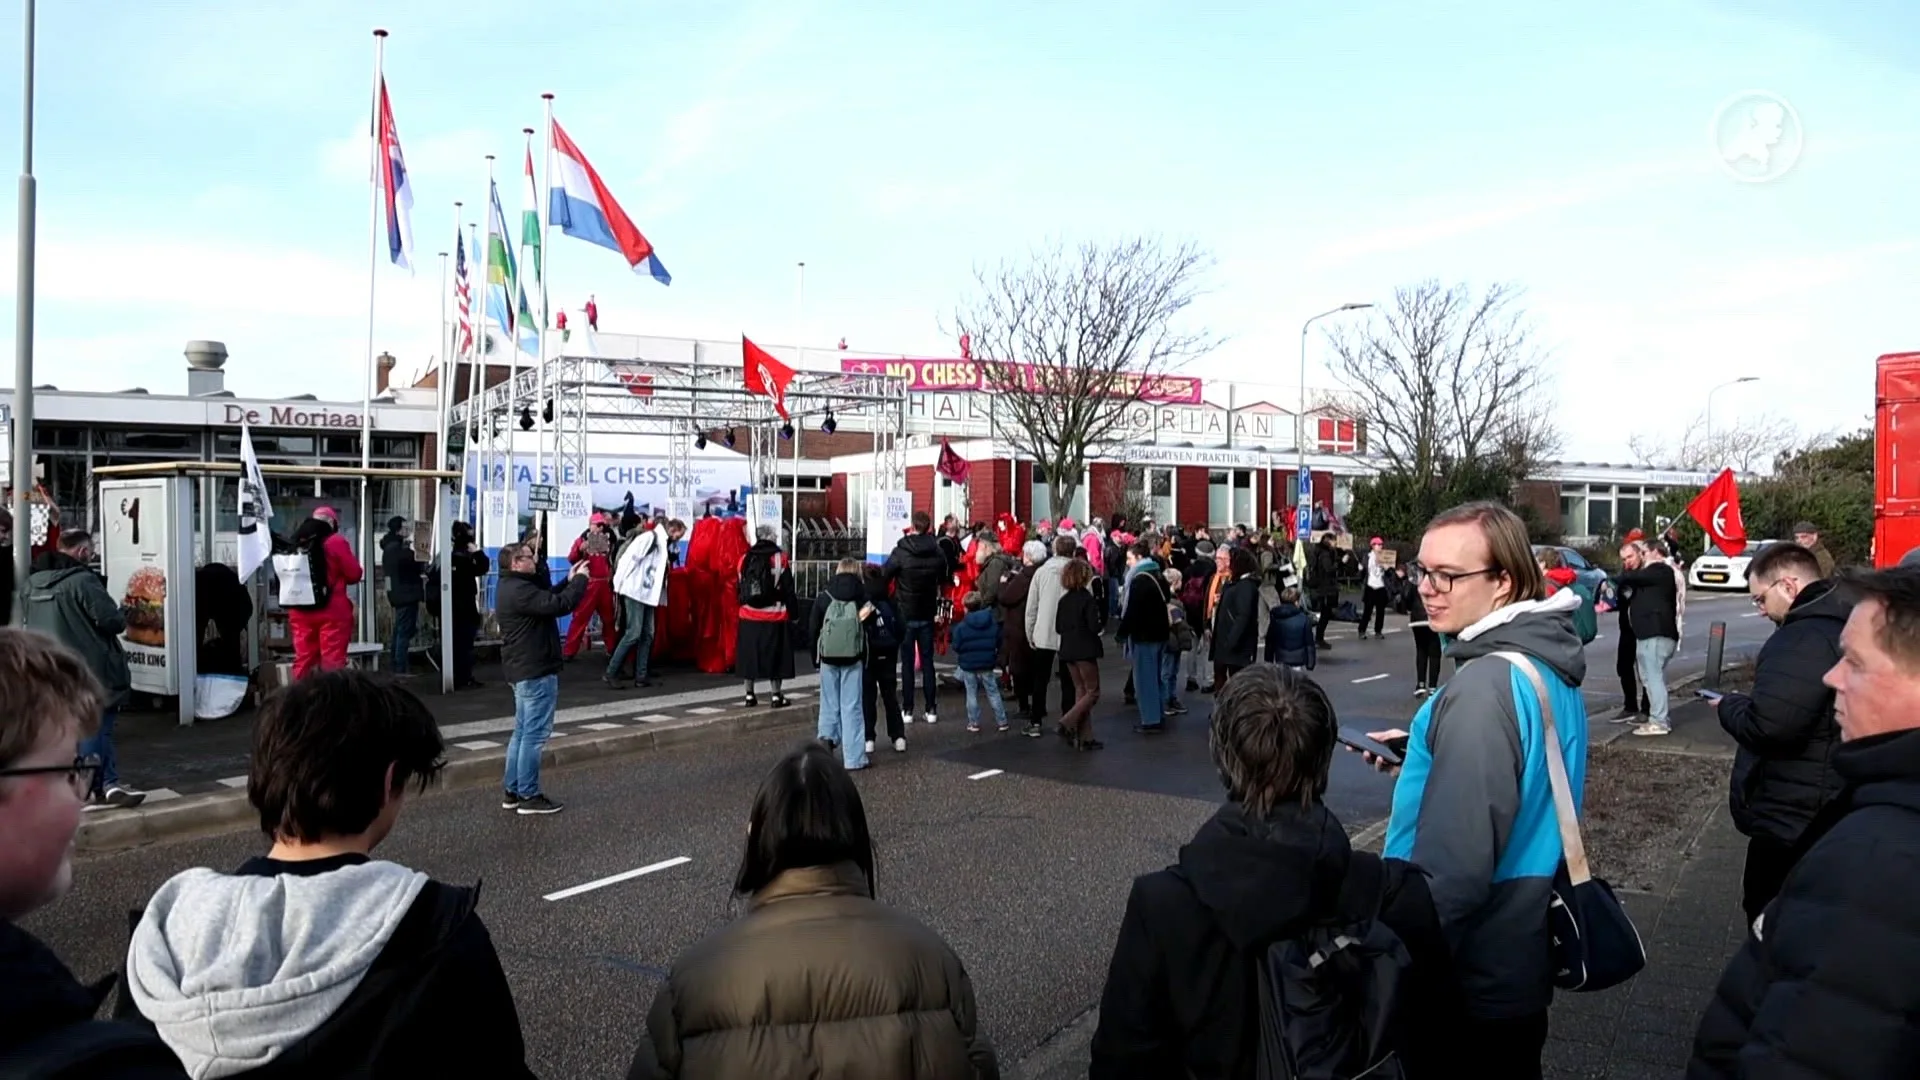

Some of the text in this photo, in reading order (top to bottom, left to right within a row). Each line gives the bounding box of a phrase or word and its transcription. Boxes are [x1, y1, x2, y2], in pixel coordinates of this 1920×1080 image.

[922, 362, 977, 386] CHESS
[224, 404, 376, 428] De Moriaan
[604, 467, 669, 485] CHESS
[1301, 467, 1309, 478] P
[561, 508, 588, 516] CHESS
[887, 511, 907, 519] CHES
[1300, 511, 1308, 526] P
[127, 651, 166, 667] RGER KING
